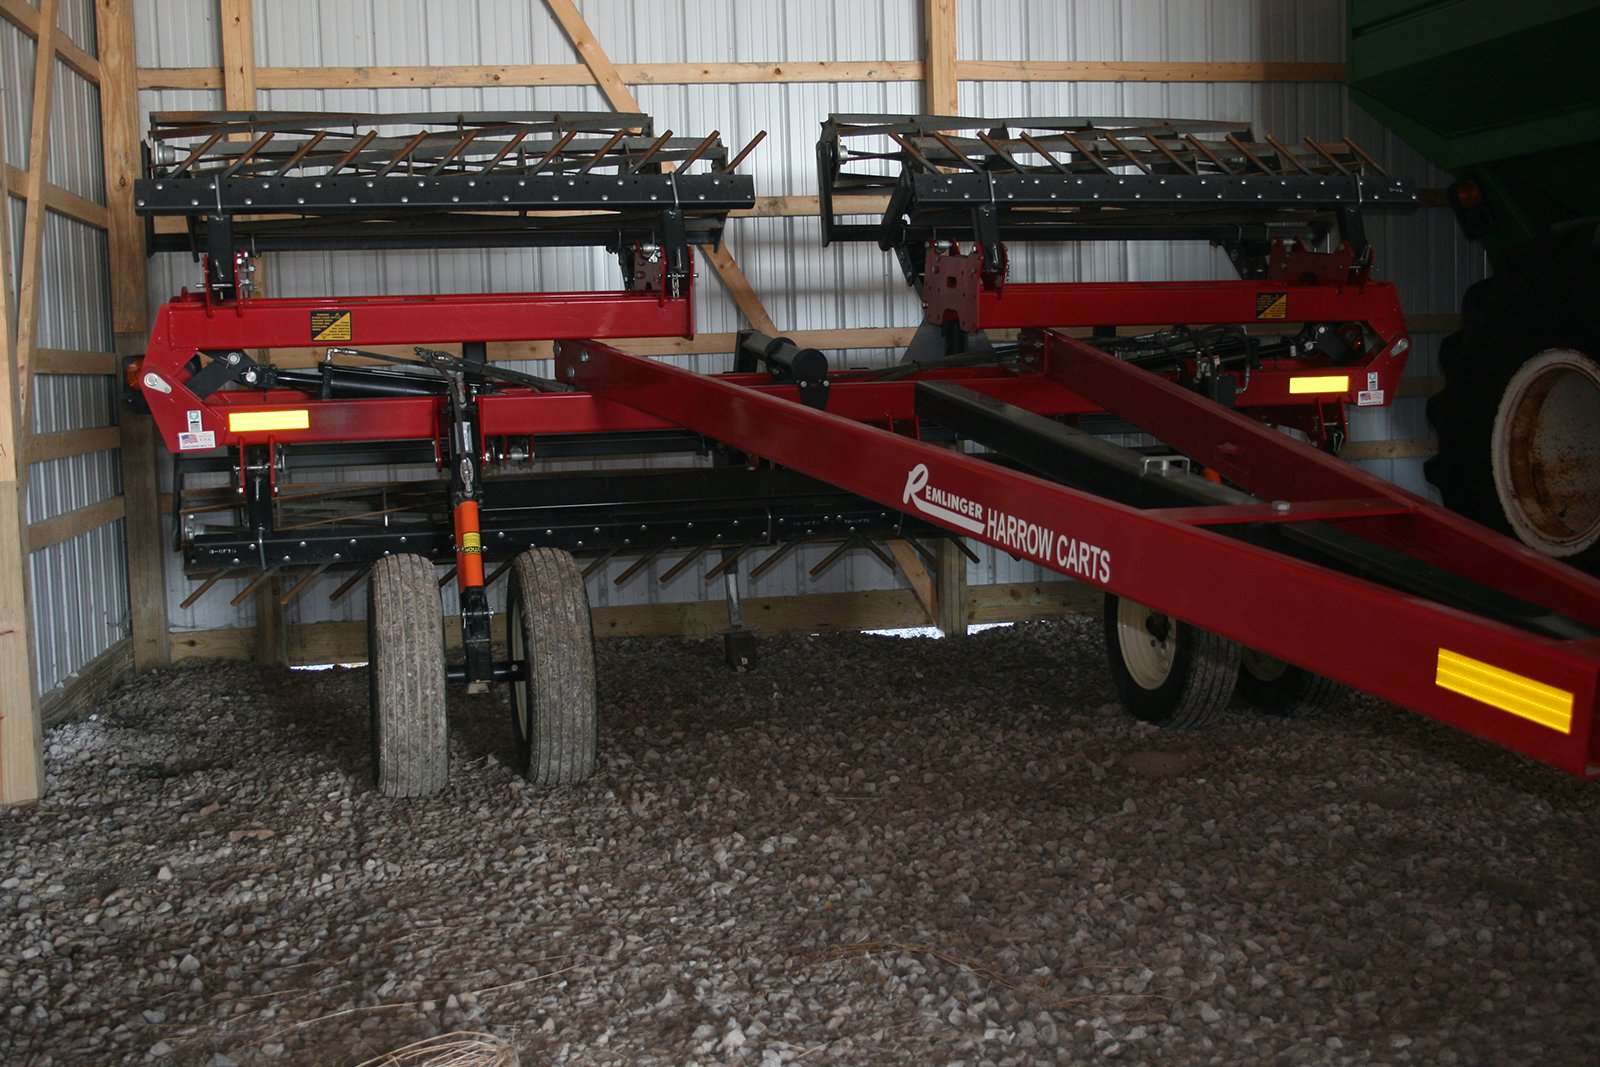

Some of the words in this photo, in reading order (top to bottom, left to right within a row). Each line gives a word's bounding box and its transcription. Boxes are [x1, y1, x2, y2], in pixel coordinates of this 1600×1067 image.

[902, 463, 985, 533] REMLINGER
[987, 508, 1054, 561] HARROW
[1056, 534, 1110, 583] CARTS
